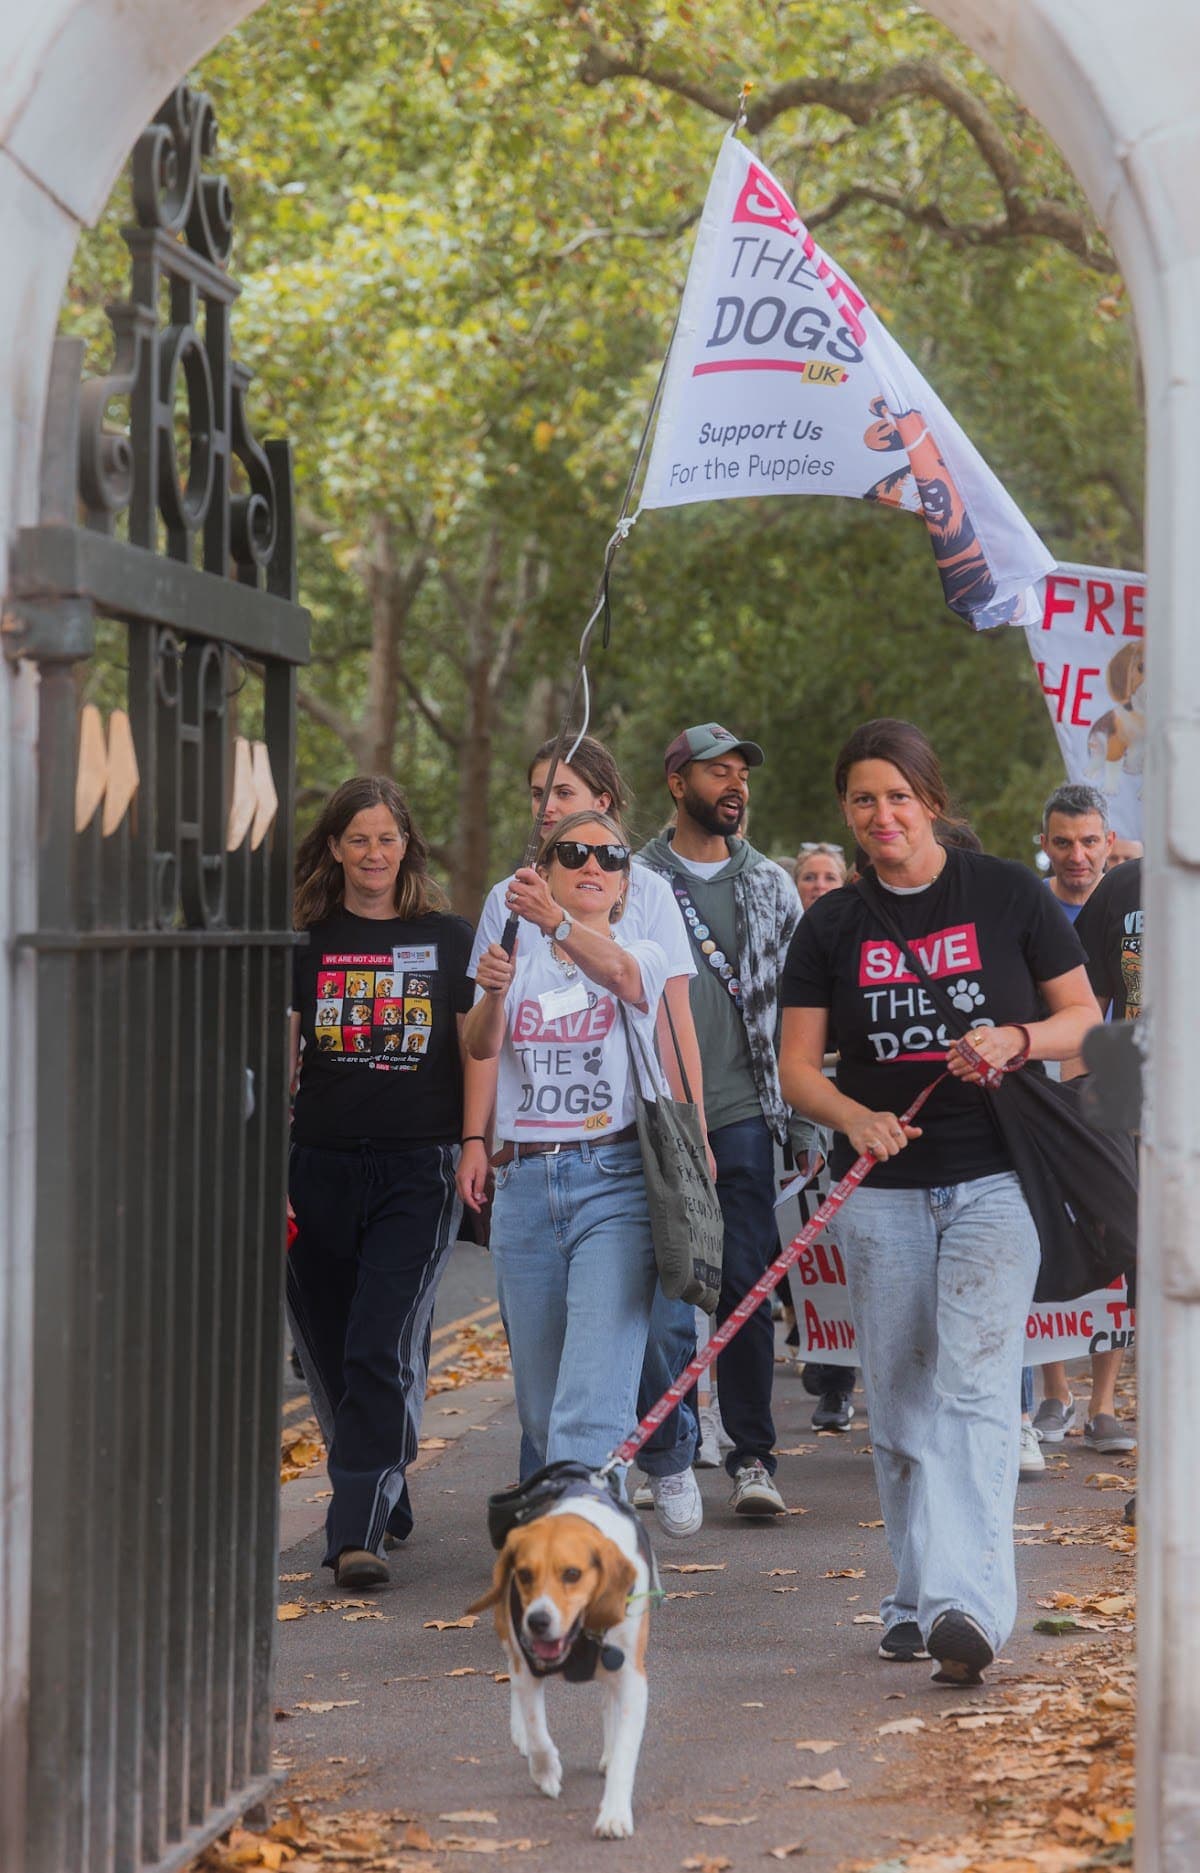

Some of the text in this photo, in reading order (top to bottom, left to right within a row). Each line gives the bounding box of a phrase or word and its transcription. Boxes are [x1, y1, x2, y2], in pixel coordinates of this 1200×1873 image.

[731, 237, 820, 291] THE
[705, 296, 864, 363] DOGS
[807, 364, 839, 383] UK
[699, 419, 823, 447] Support Us
[670, 454, 835, 487] For the Puppies
[326, 955, 337, 963] WE
[338, 955, 352, 963] ARE
[353, 955, 368, 963] NOT
[368, 955, 386, 963] JUST
[519, 1003, 608, 1038] SAVE
[864, 988, 936, 1022] THE
[515, 1047, 572, 1075] THE
[518, 1080, 613, 1114] DOGS
[585, 1115, 605, 1130] UK
